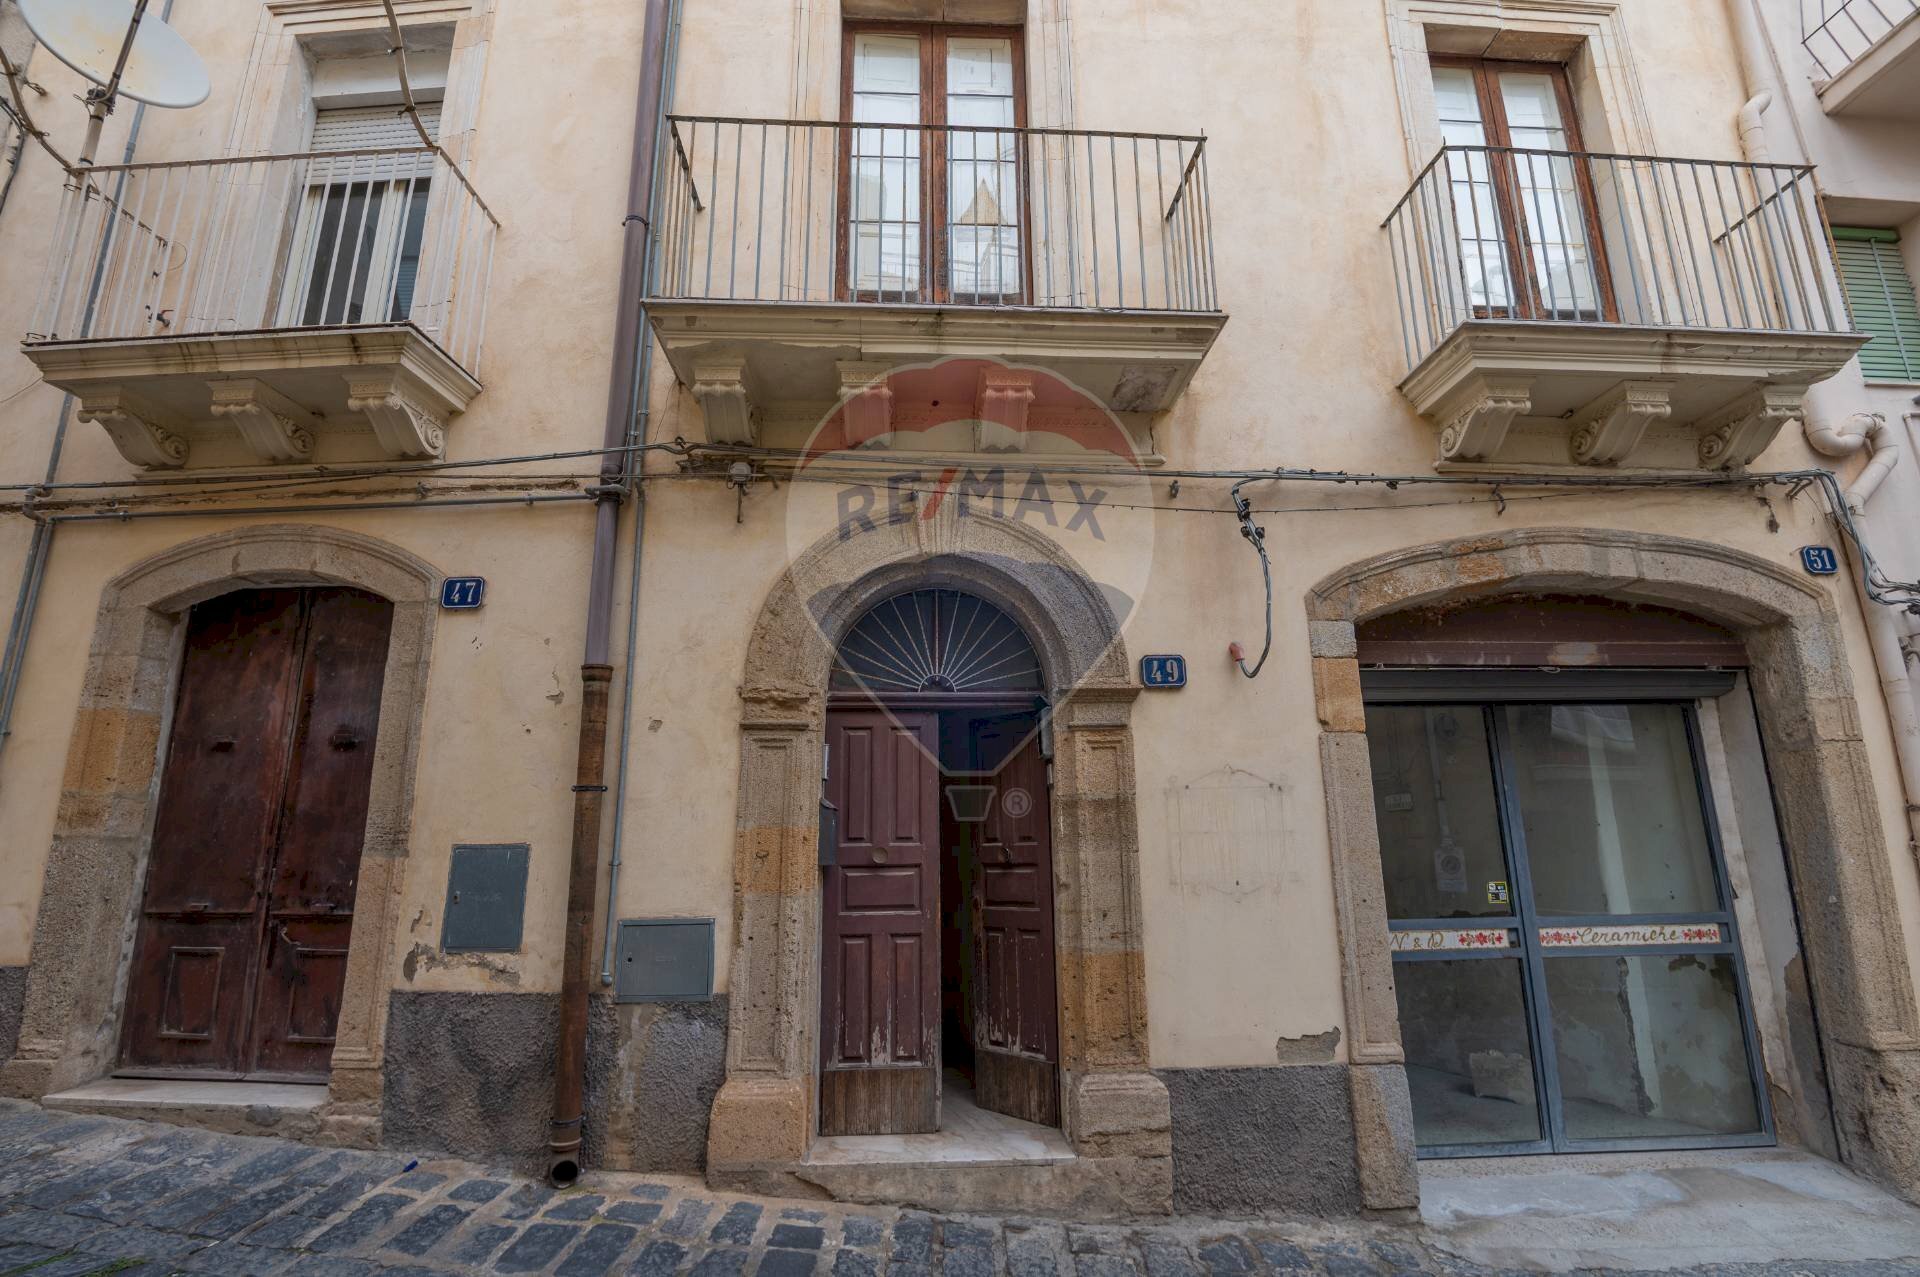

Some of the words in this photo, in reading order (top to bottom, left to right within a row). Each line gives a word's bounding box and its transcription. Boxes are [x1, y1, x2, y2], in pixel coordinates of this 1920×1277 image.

[1809, 549, 1833, 569] 51
[450, 582, 477, 603] 47
[1151, 659, 1179, 682] 49
[1413, 937, 1422, 950] &
[1576, 926, 1680, 944] Ceramiche
